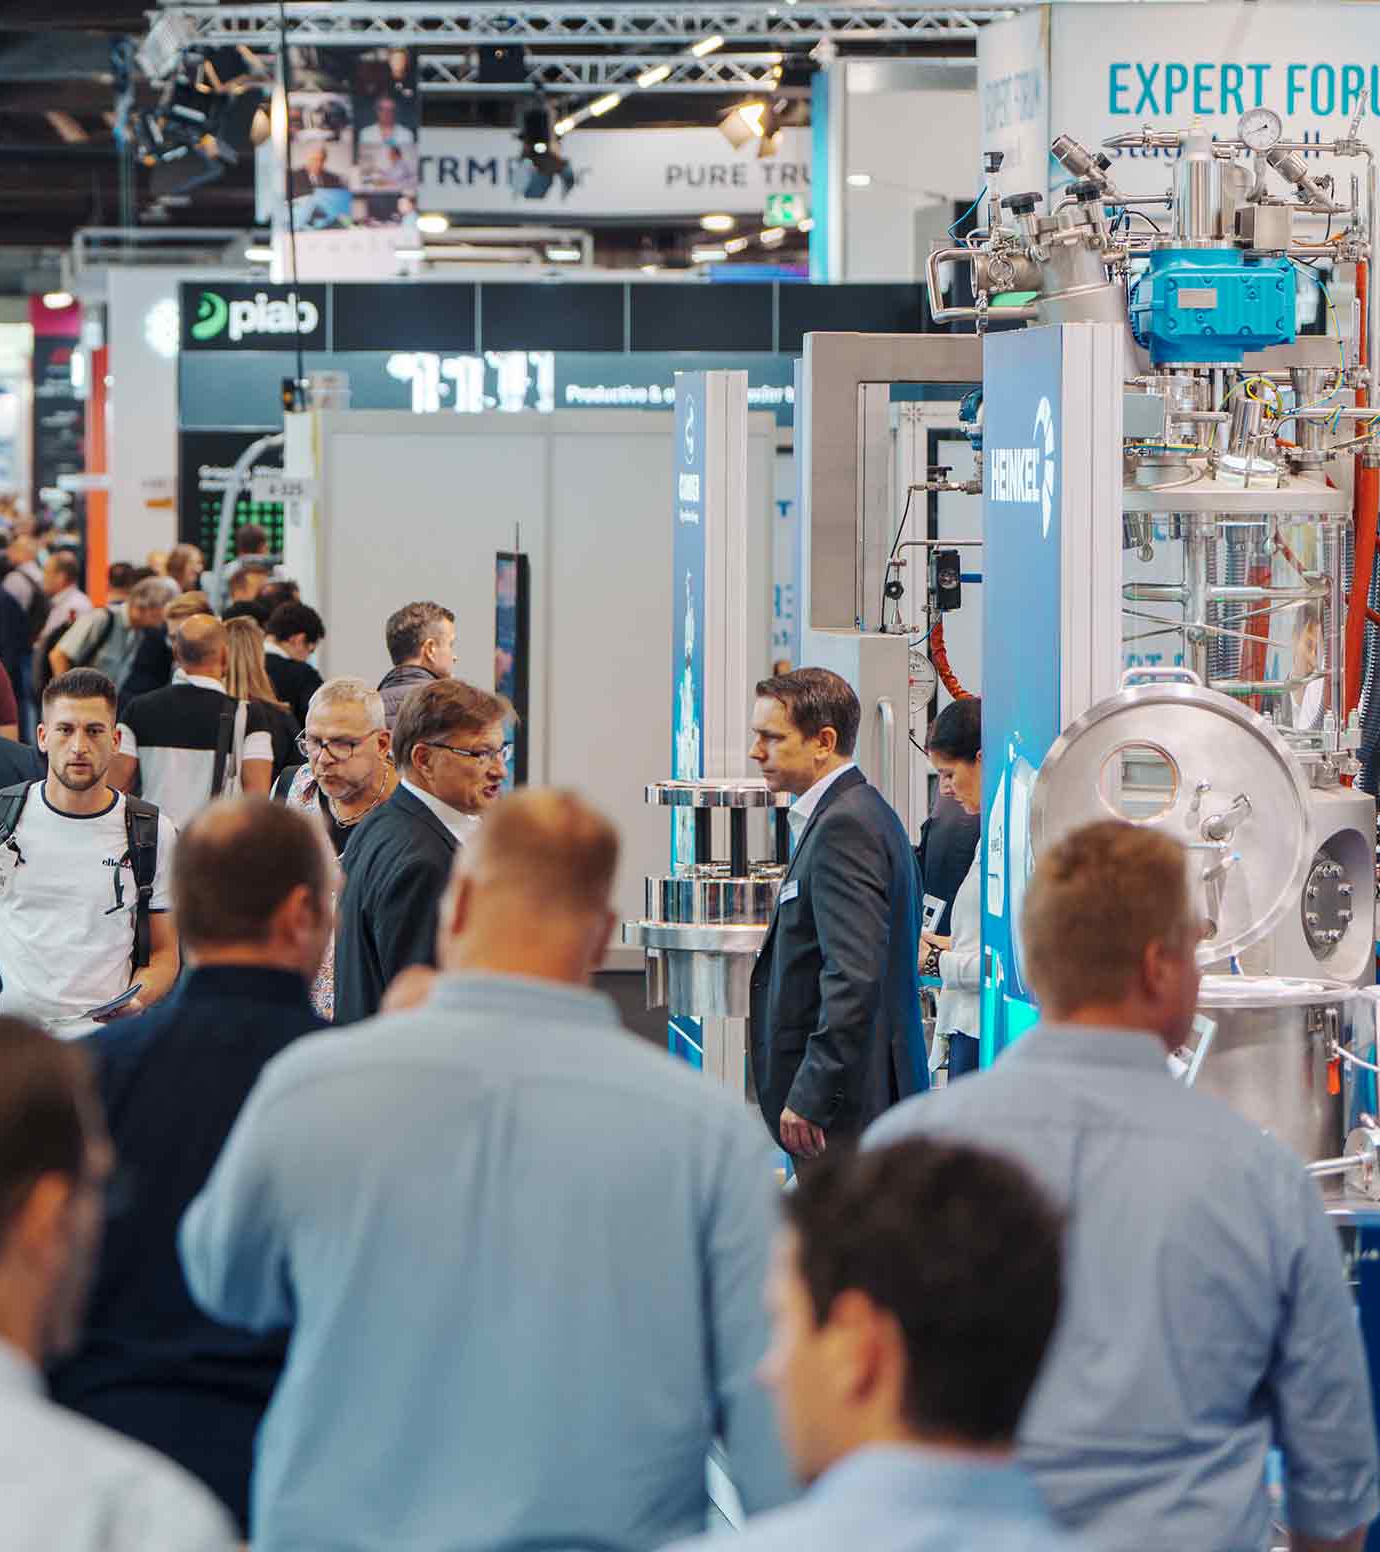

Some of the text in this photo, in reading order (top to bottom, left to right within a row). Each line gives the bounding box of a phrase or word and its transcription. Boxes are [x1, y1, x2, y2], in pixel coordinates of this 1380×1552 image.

[1109, 63, 1271, 115] EXPERT
[665, 162, 749, 187] PURE
[228, 292, 319, 341] piab
[991, 448, 1040, 502] HEINKEL
